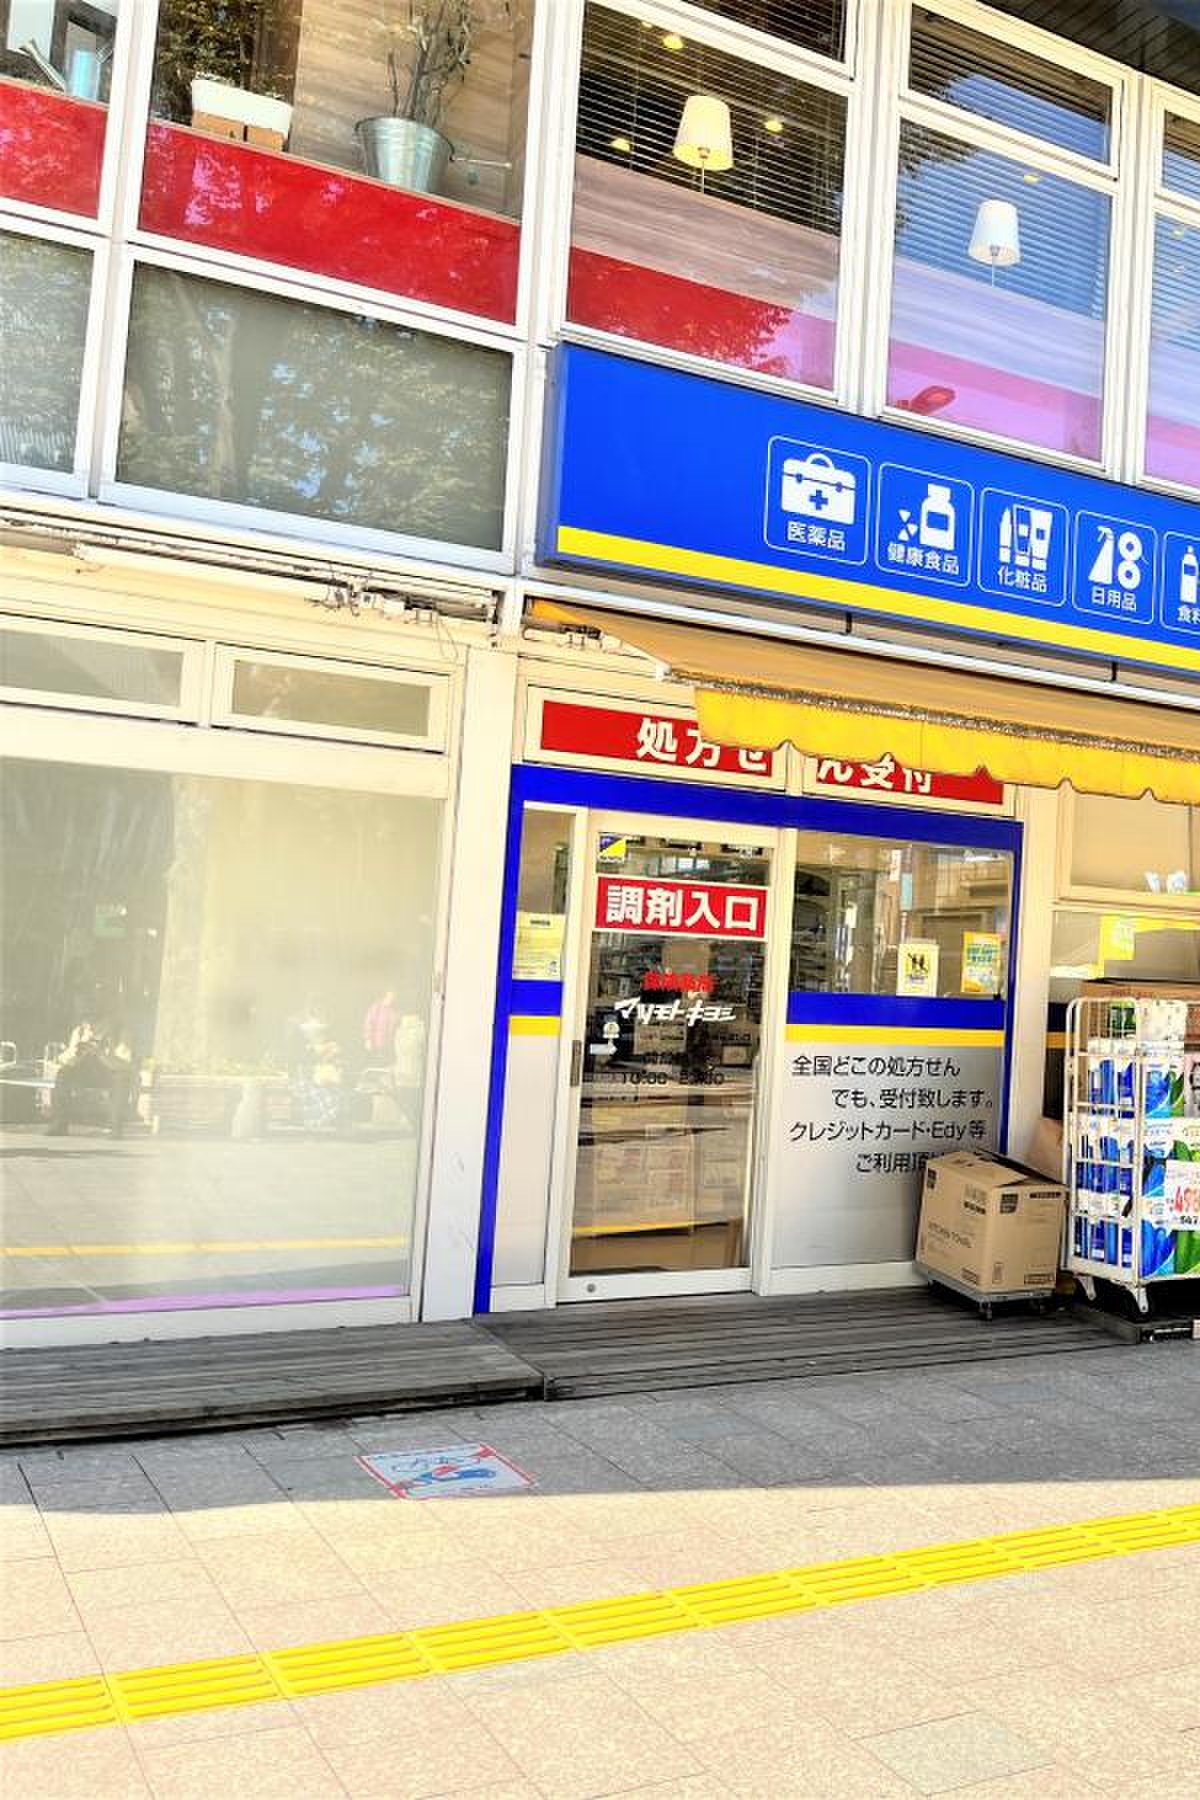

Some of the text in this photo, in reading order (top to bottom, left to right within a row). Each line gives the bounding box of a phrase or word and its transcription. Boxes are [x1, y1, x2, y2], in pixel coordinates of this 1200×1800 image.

[786, 521, 846, 551] 医薬品
[887, 543, 960, 575] 健康食品
[998, 567, 1048, 593] 化粧品
[1091, 586, 1137, 612] 日用品
[606, 884, 760, 932] 調剤入口
[613, 996, 737, 1027] マツモトキヨシ
[791, 1055, 961, 1078] 全国どこの処方せん
[831, 1087, 995, 1109] でも、受付致します。
